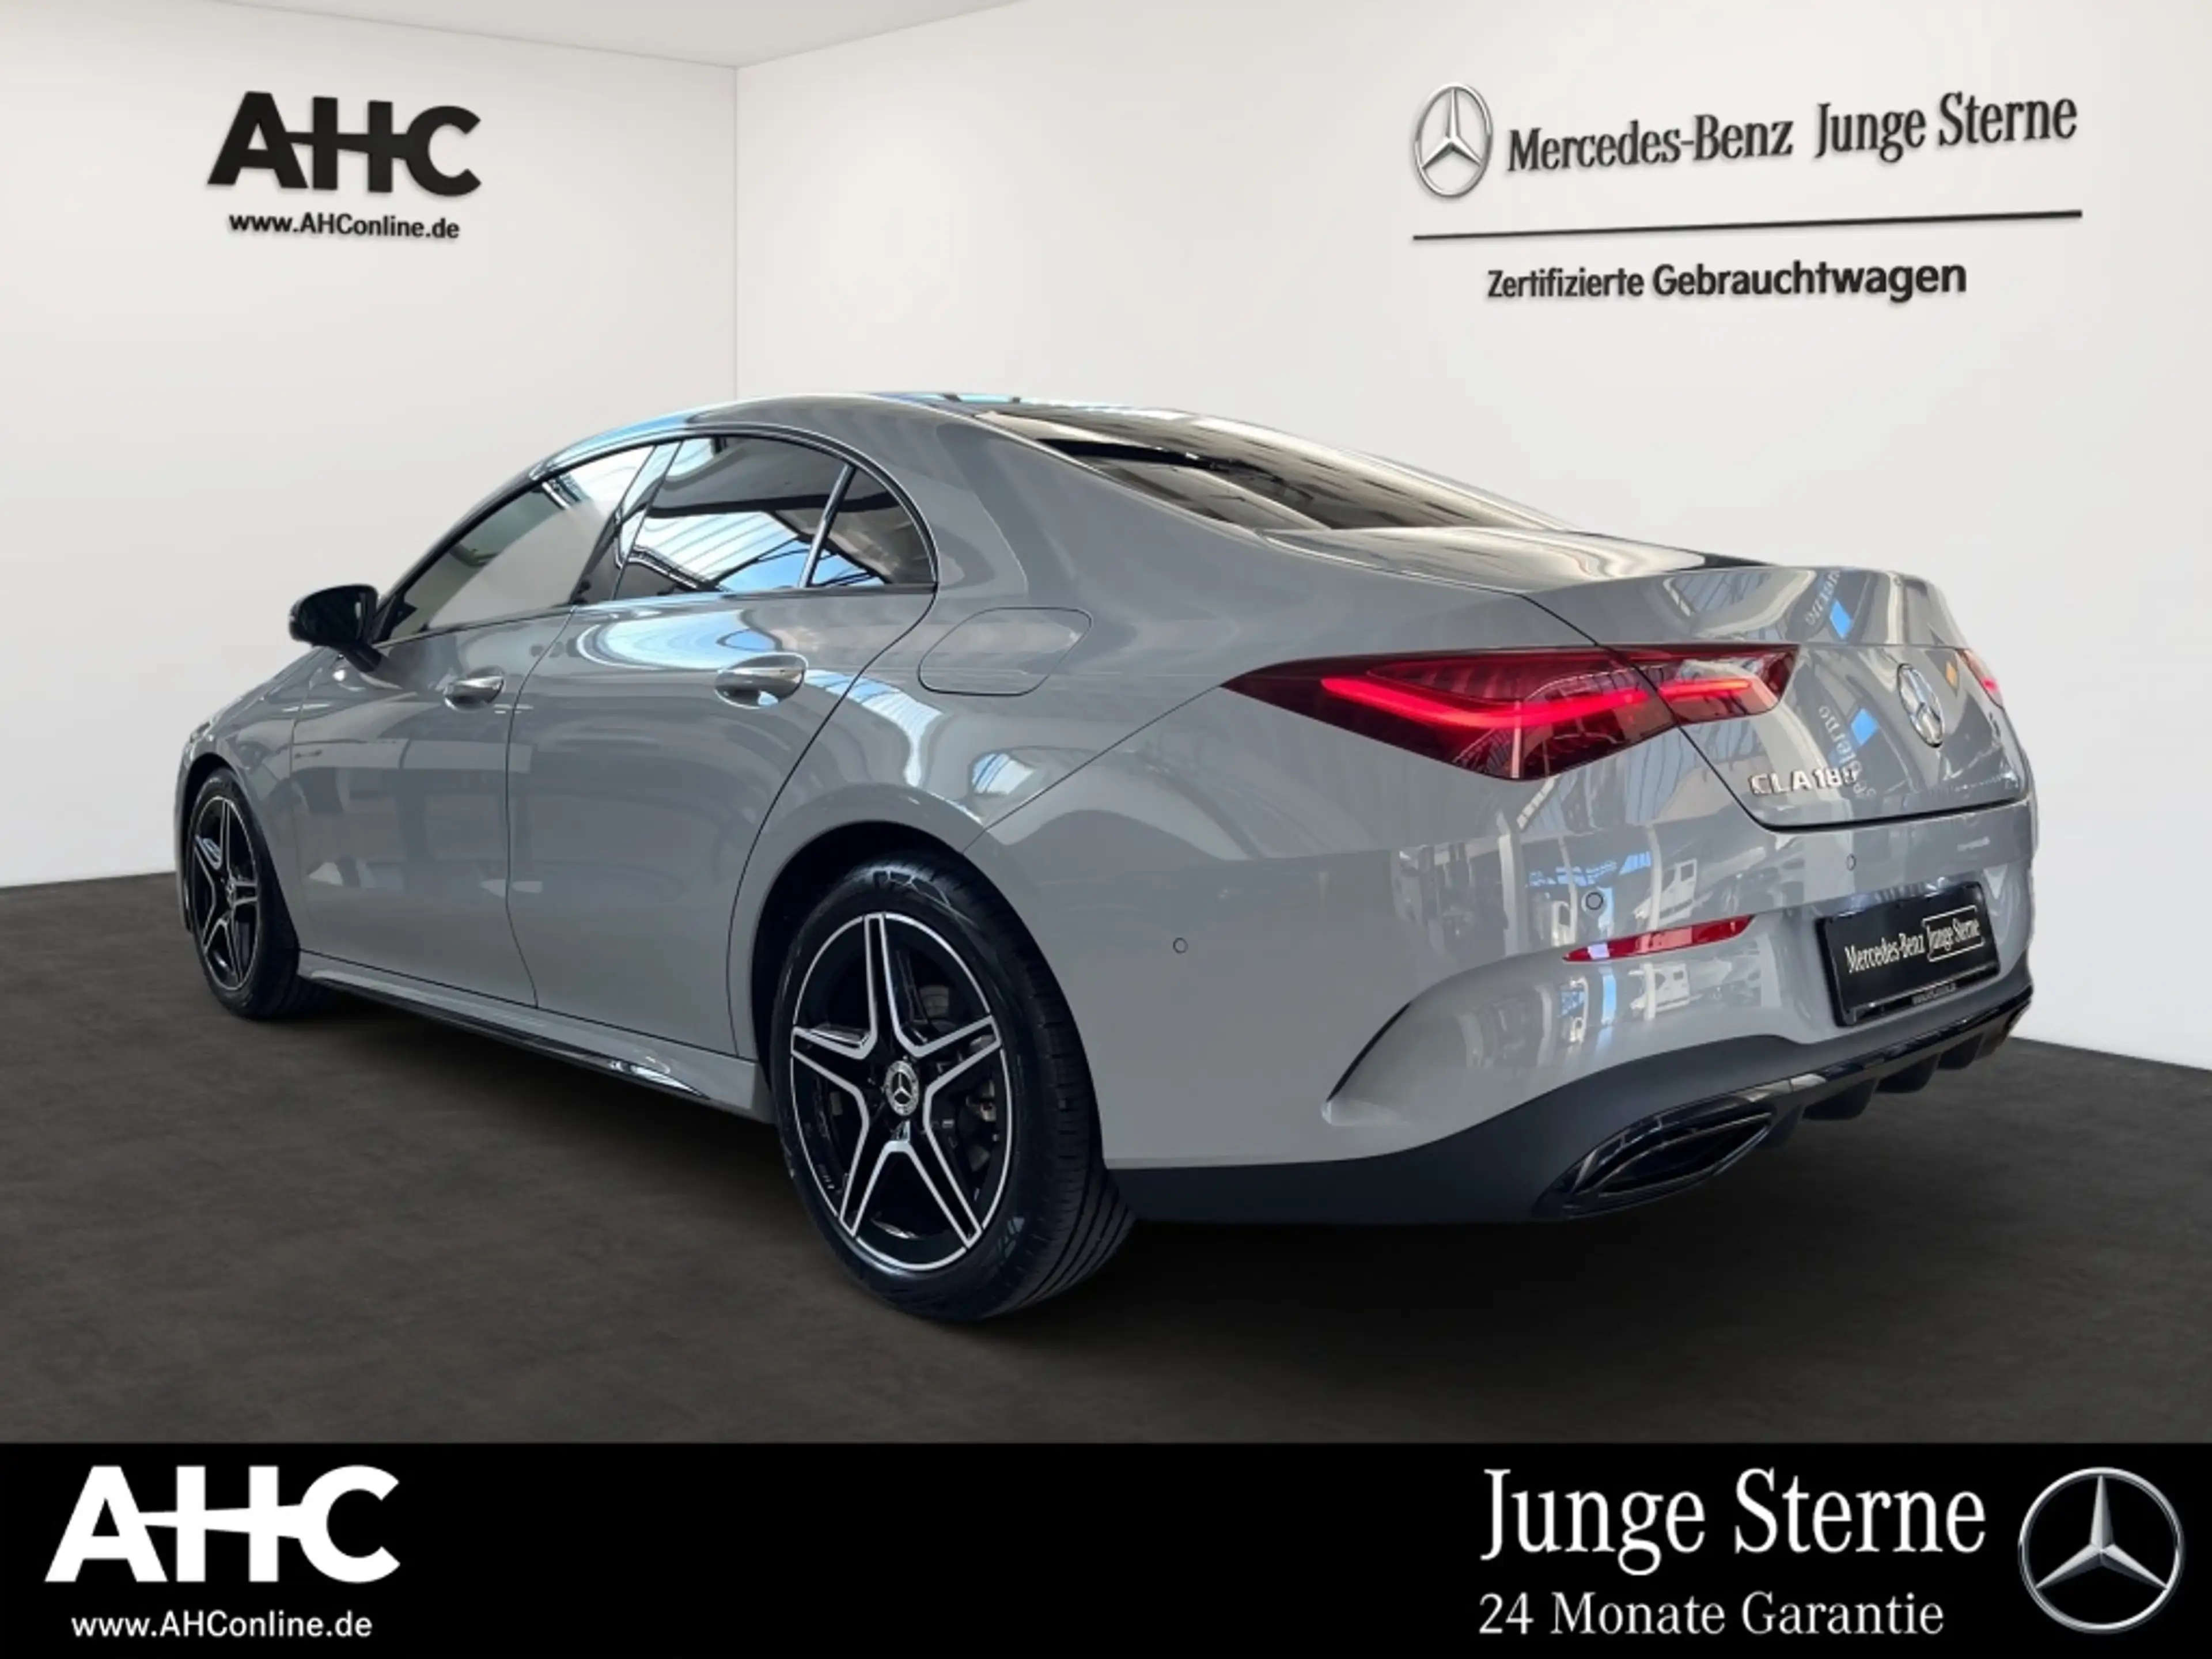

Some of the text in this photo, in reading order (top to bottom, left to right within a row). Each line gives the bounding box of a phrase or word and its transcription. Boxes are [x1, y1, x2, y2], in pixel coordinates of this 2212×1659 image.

[207, 91, 481, 197] AHC
[1508, 91, 2078, 172] Mercedes-Benz Junge Sterne
[229, 211, 460, 239] www.AHConline.de
[1487, 260, 1967, 304] Zertifizierte Gebrauchtwagen
[1844, 917, 1980, 974] Mercedes-Benz Junge Sterne
